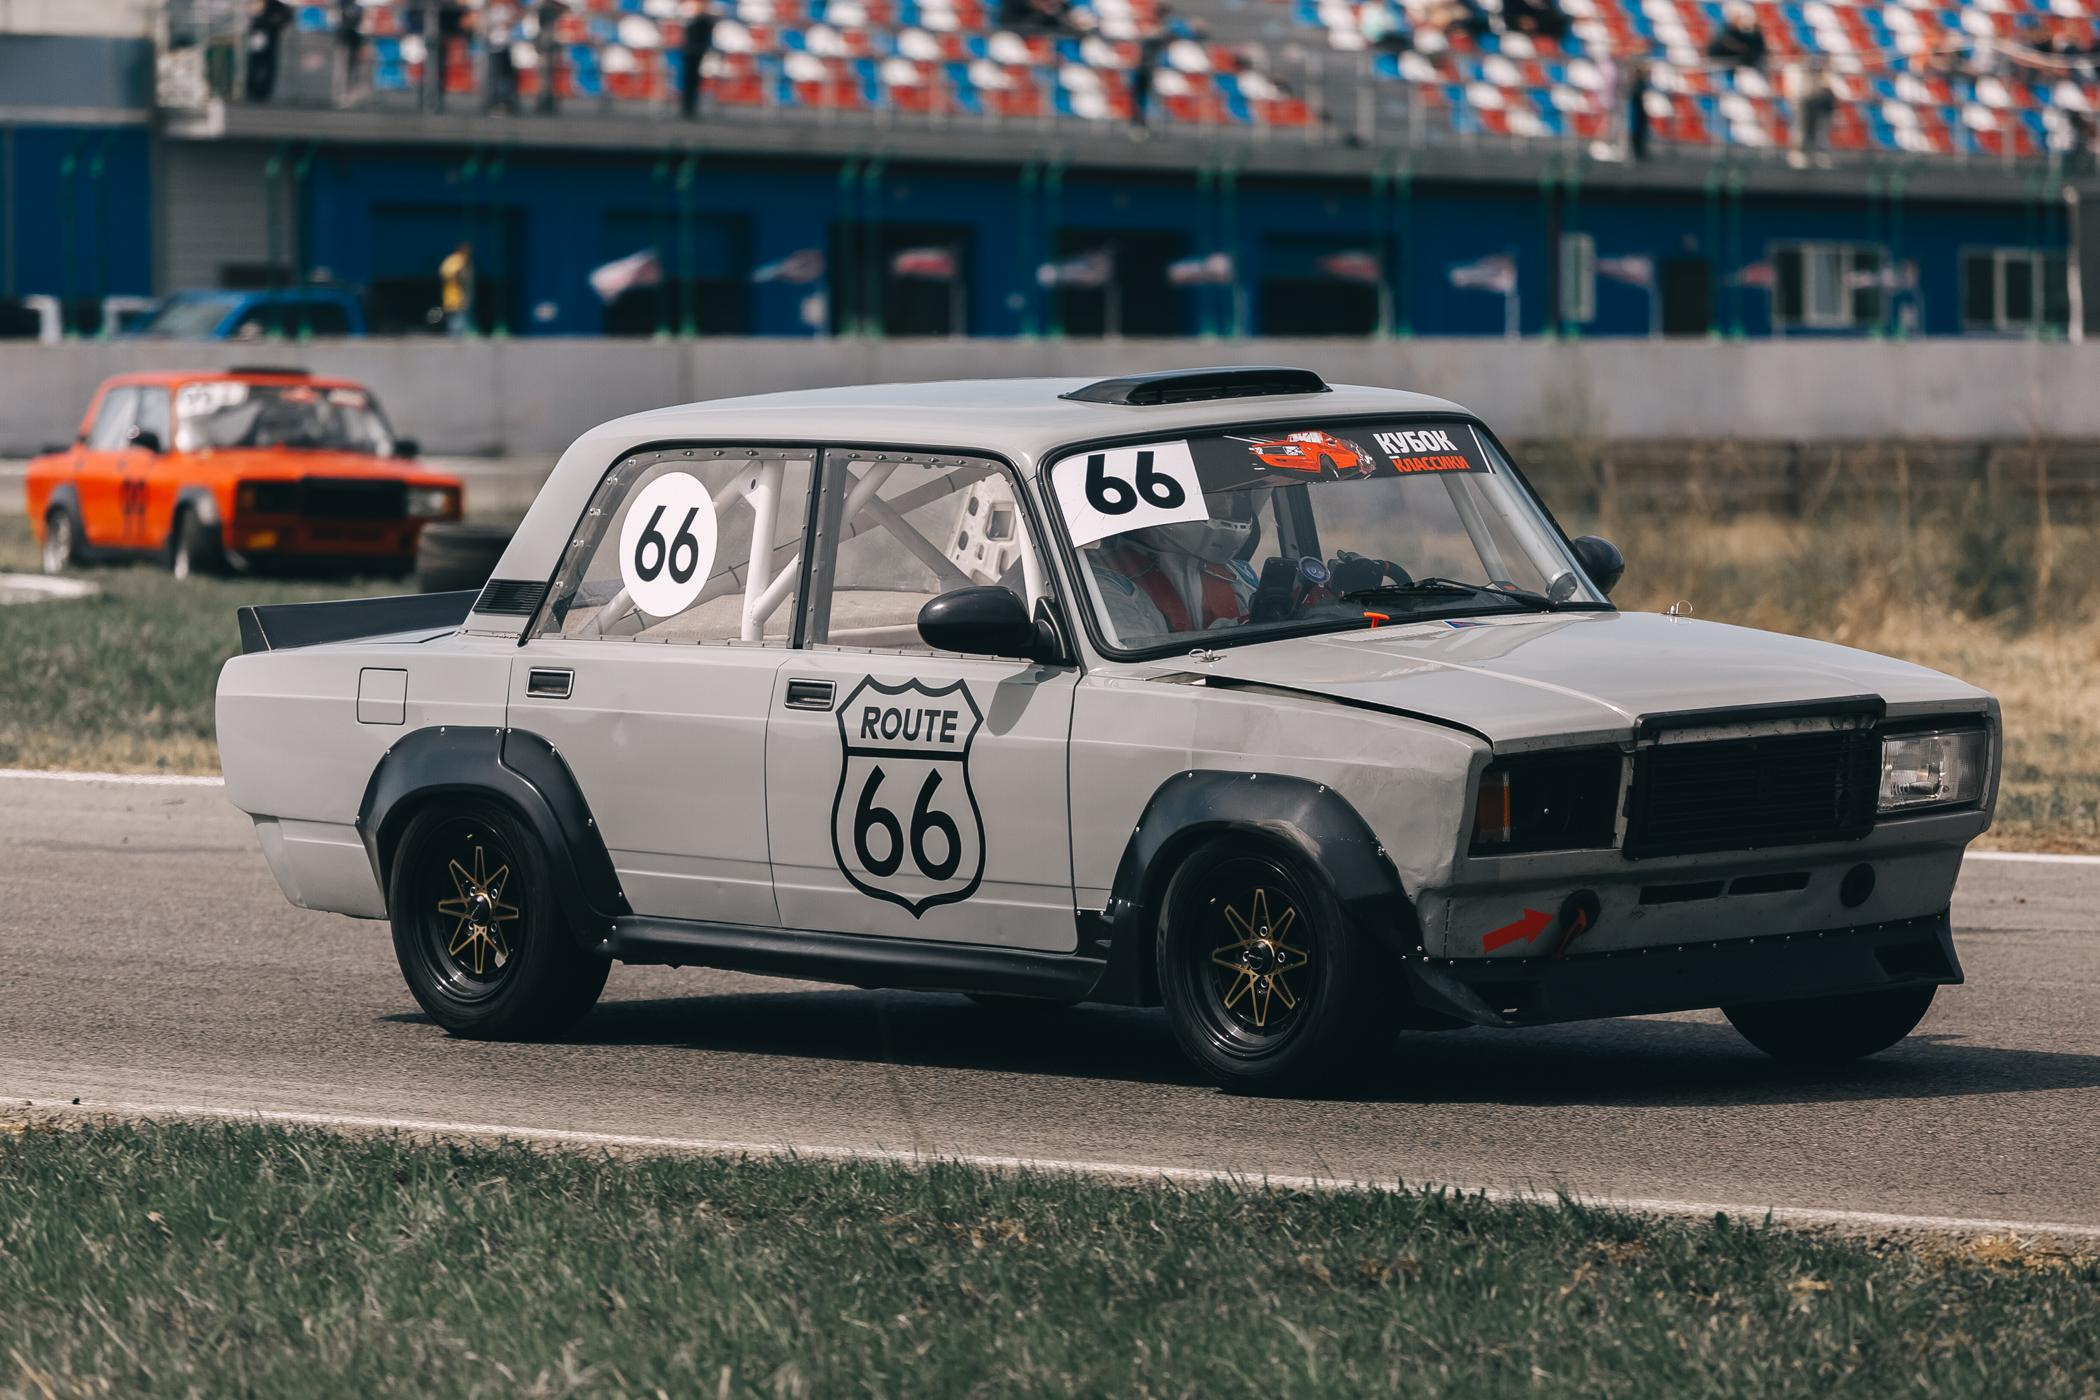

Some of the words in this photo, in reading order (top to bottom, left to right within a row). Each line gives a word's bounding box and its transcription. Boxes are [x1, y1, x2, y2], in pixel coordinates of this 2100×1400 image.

[1373, 431, 1458, 454] КУБОК
[1392, 456, 1471, 473] КЛАССИКИ
[1085, 451, 1186, 515] 66
[634, 505, 699, 584] 66
[860, 706, 958, 743] ROUTE
[854, 765, 962, 881] 66
